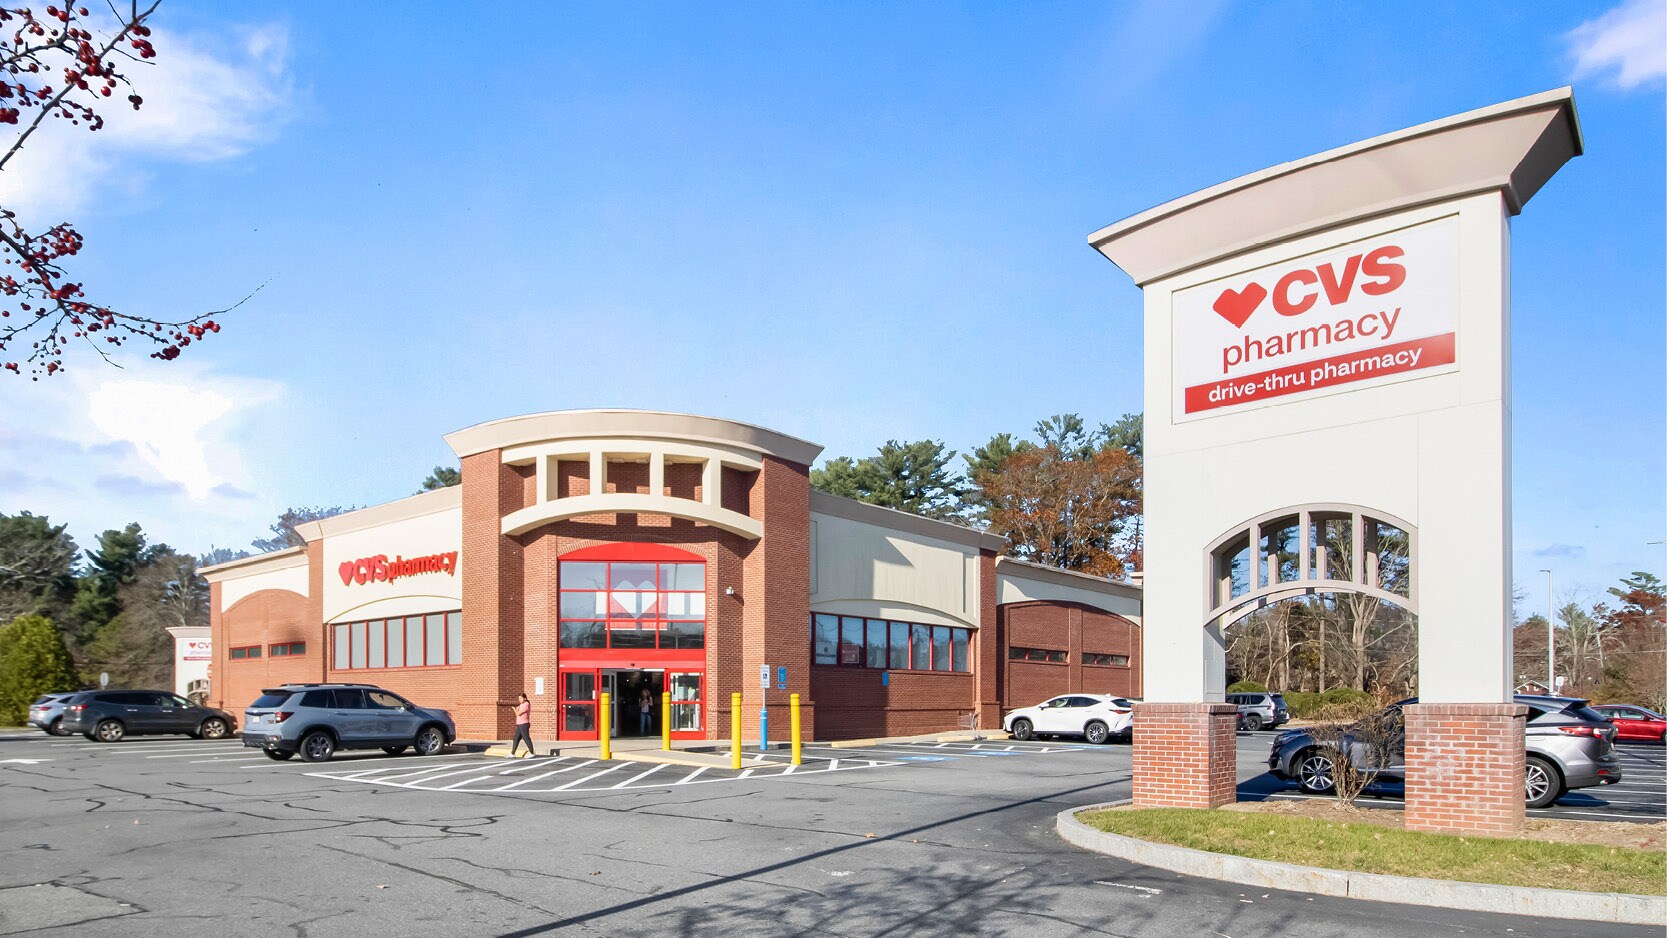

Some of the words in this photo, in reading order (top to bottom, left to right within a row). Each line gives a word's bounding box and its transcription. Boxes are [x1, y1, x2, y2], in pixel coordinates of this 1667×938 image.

[1272, 245, 1407, 316] CVS
[1223, 307, 1401, 373] pharmacy
[1208, 371, 1306, 403] drive-thru
[1310, 347, 1422, 386] pharmacy
[354, 554, 388, 585] CVS
[388, 551, 458, 585] pharmacy
